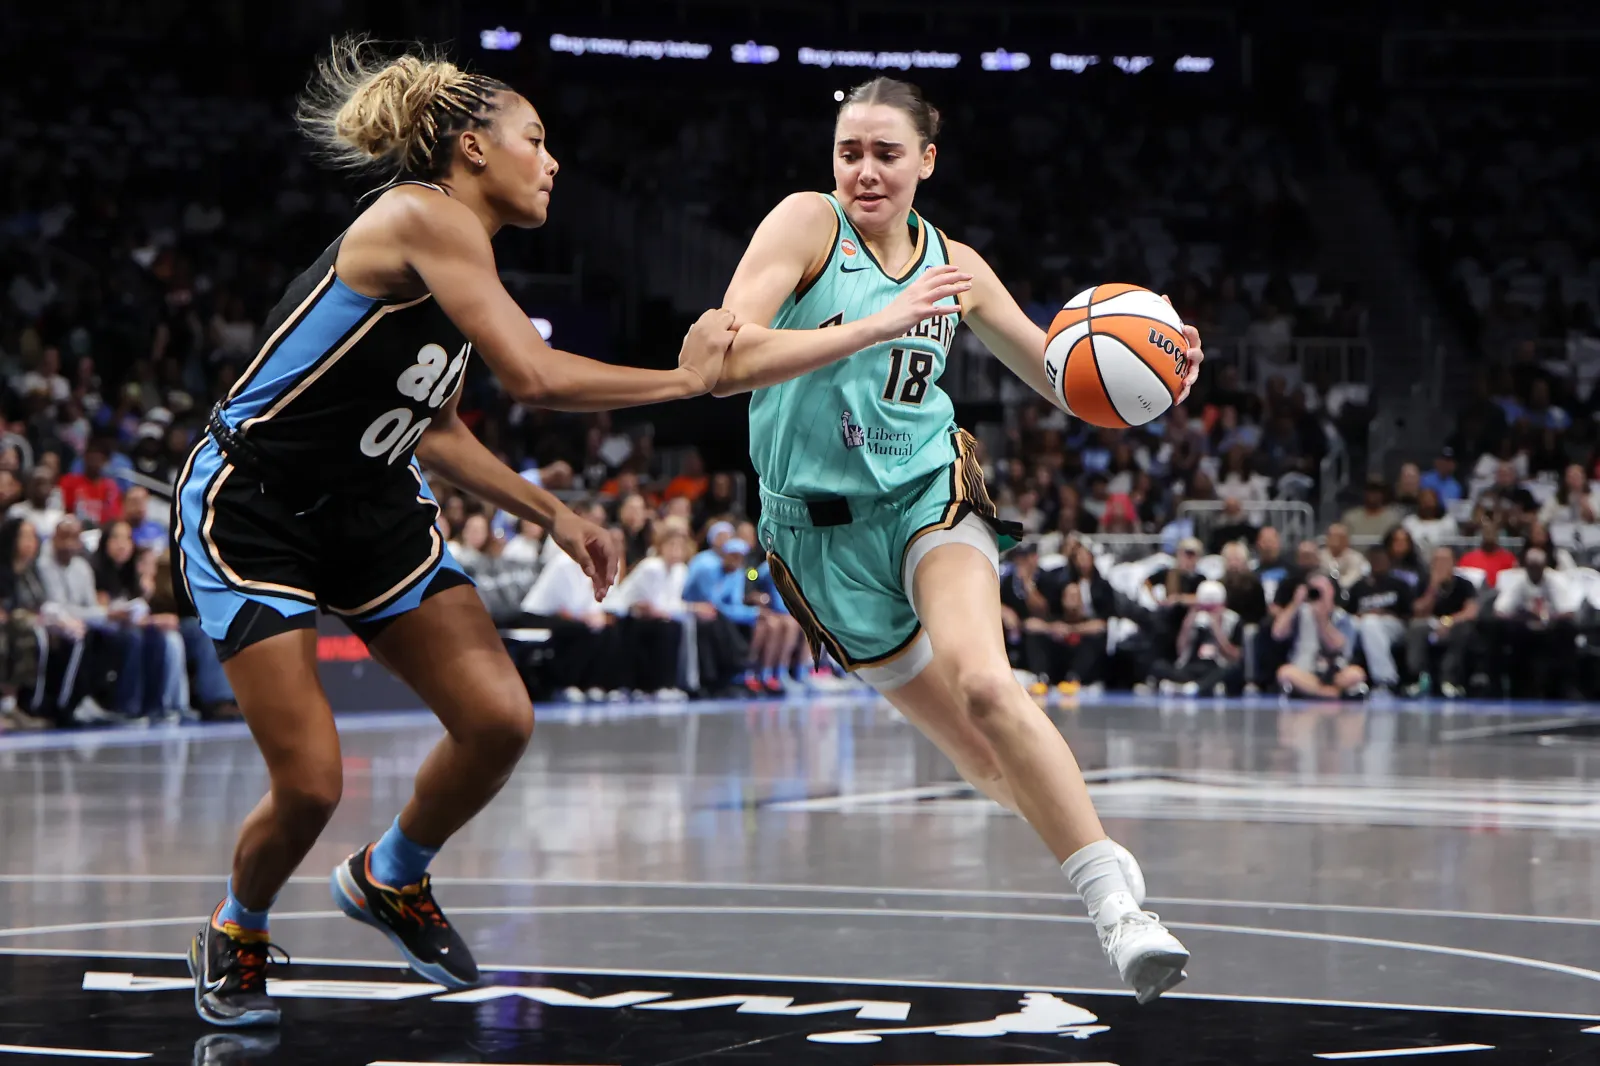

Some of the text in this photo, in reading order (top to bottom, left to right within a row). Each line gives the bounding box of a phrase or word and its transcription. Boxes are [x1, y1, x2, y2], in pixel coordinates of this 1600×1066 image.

[881, 348, 935, 406] 18
[360, 407, 432, 466] 00
[866, 427, 913, 442] Liberty
[866, 442, 912, 456] Mutual
